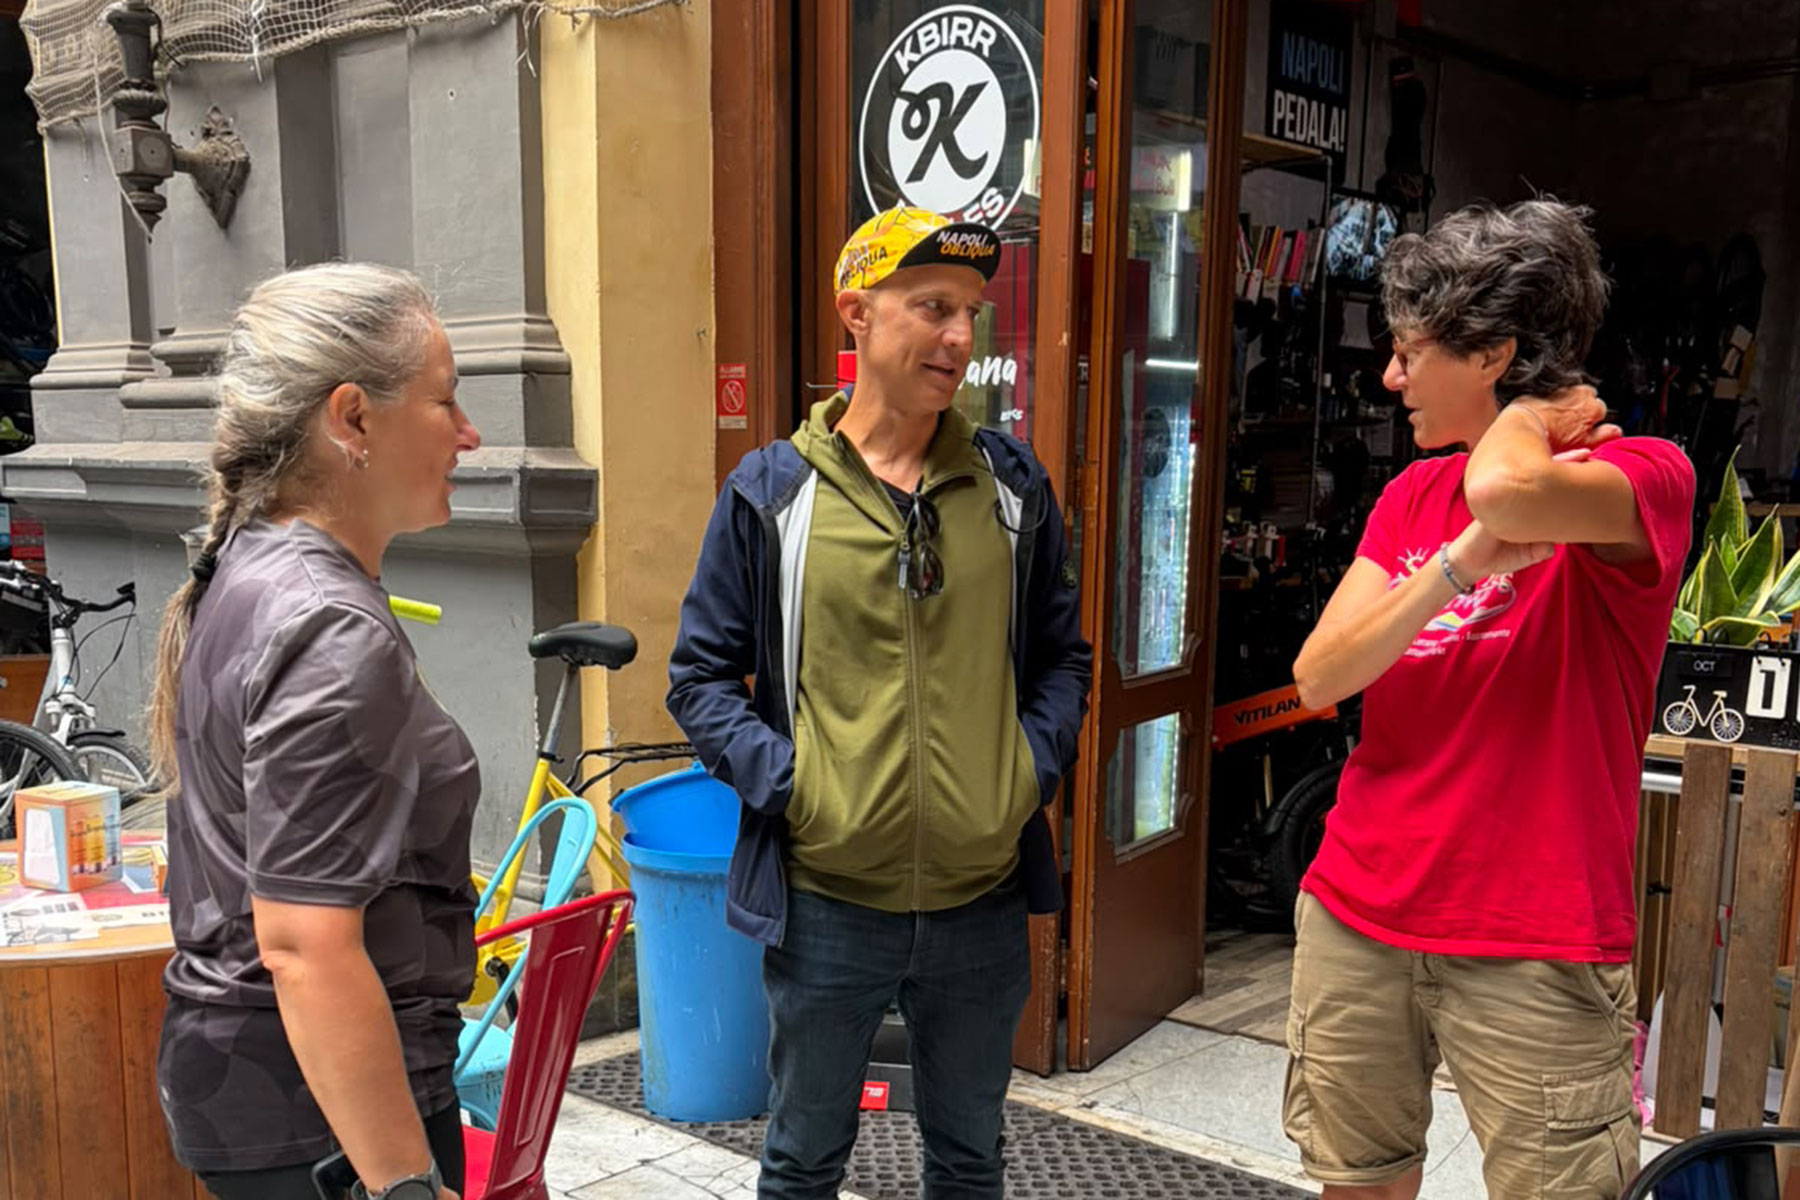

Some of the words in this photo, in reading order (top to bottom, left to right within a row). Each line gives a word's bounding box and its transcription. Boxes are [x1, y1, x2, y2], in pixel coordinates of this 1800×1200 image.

[894, 16, 997, 75] KBIRR
[1281, 30, 1345, 94] NAPOLI
[1273, 90, 1346, 152] PEDALA!
[936, 230, 988, 244] NAPOLI
[939, 241, 997, 260] OBLIQUA
[958, 355, 1018, 390] ana
[1693, 660, 1716, 672] OCT
[1760, 669, 1776, 710] 1
